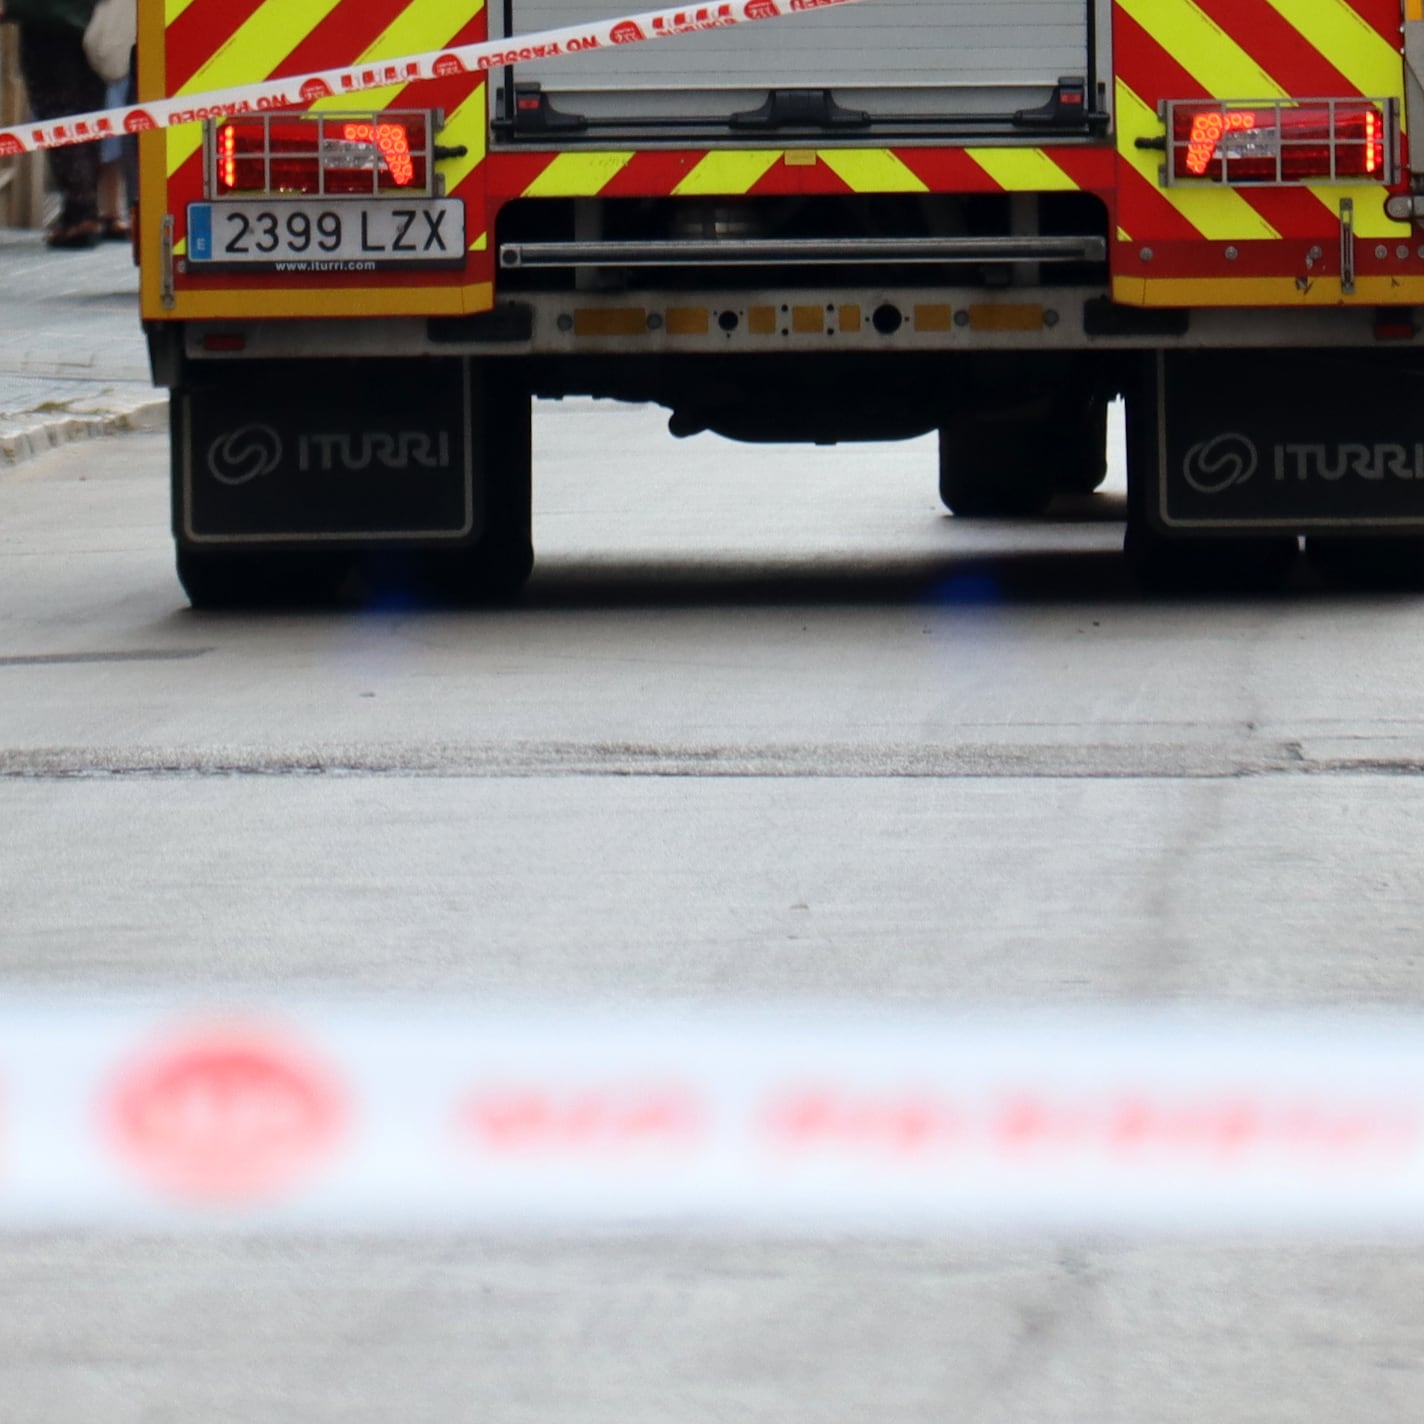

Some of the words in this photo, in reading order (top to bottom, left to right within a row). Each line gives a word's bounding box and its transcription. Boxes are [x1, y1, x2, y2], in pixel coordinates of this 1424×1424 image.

[566, 34, 599, 53] NO
[477, 42, 563, 71] PASSEU
[257, 92, 291, 112] NO
[224, 210, 343, 254] 2399
[360, 208, 447, 253] LZX
[275, 260, 376, 272] www.iturri.com
[298, 429, 450, 474] ITURRI
